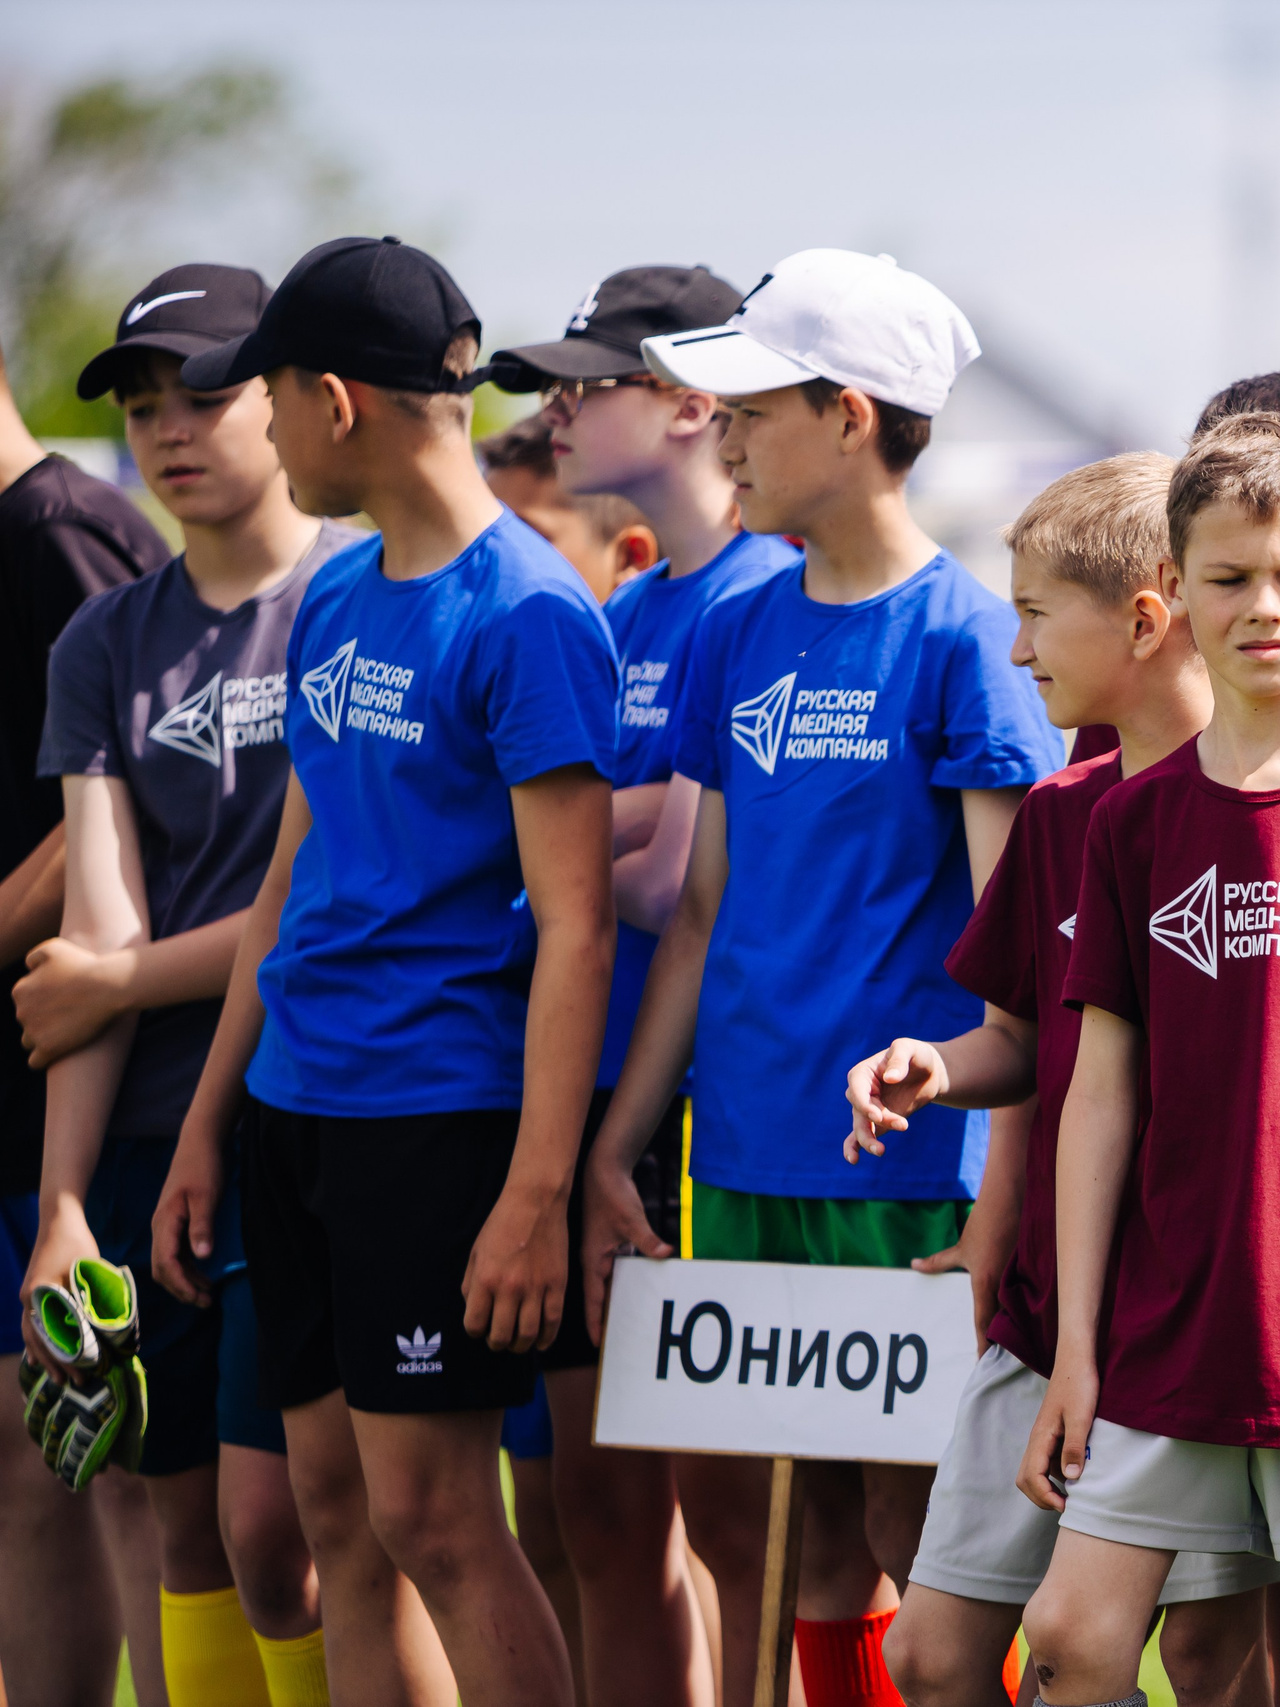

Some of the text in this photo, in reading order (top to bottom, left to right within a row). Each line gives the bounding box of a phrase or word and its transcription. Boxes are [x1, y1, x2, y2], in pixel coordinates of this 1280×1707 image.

[222, 671, 287, 702] РУССК
[353, 656, 414, 691] РУССКАЯ
[222, 695, 287, 728] МЕДН
[795, 689, 878, 712] РУССКАЯ
[223, 718, 285, 750] КОМП
[789, 713, 869, 736] МЕДНАЯ
[784, 737, 889, 761] КОМПАНИЯ
[396, 1359, 443, 1374] adidas
[655, 1299, 929, 1415] Юниор
